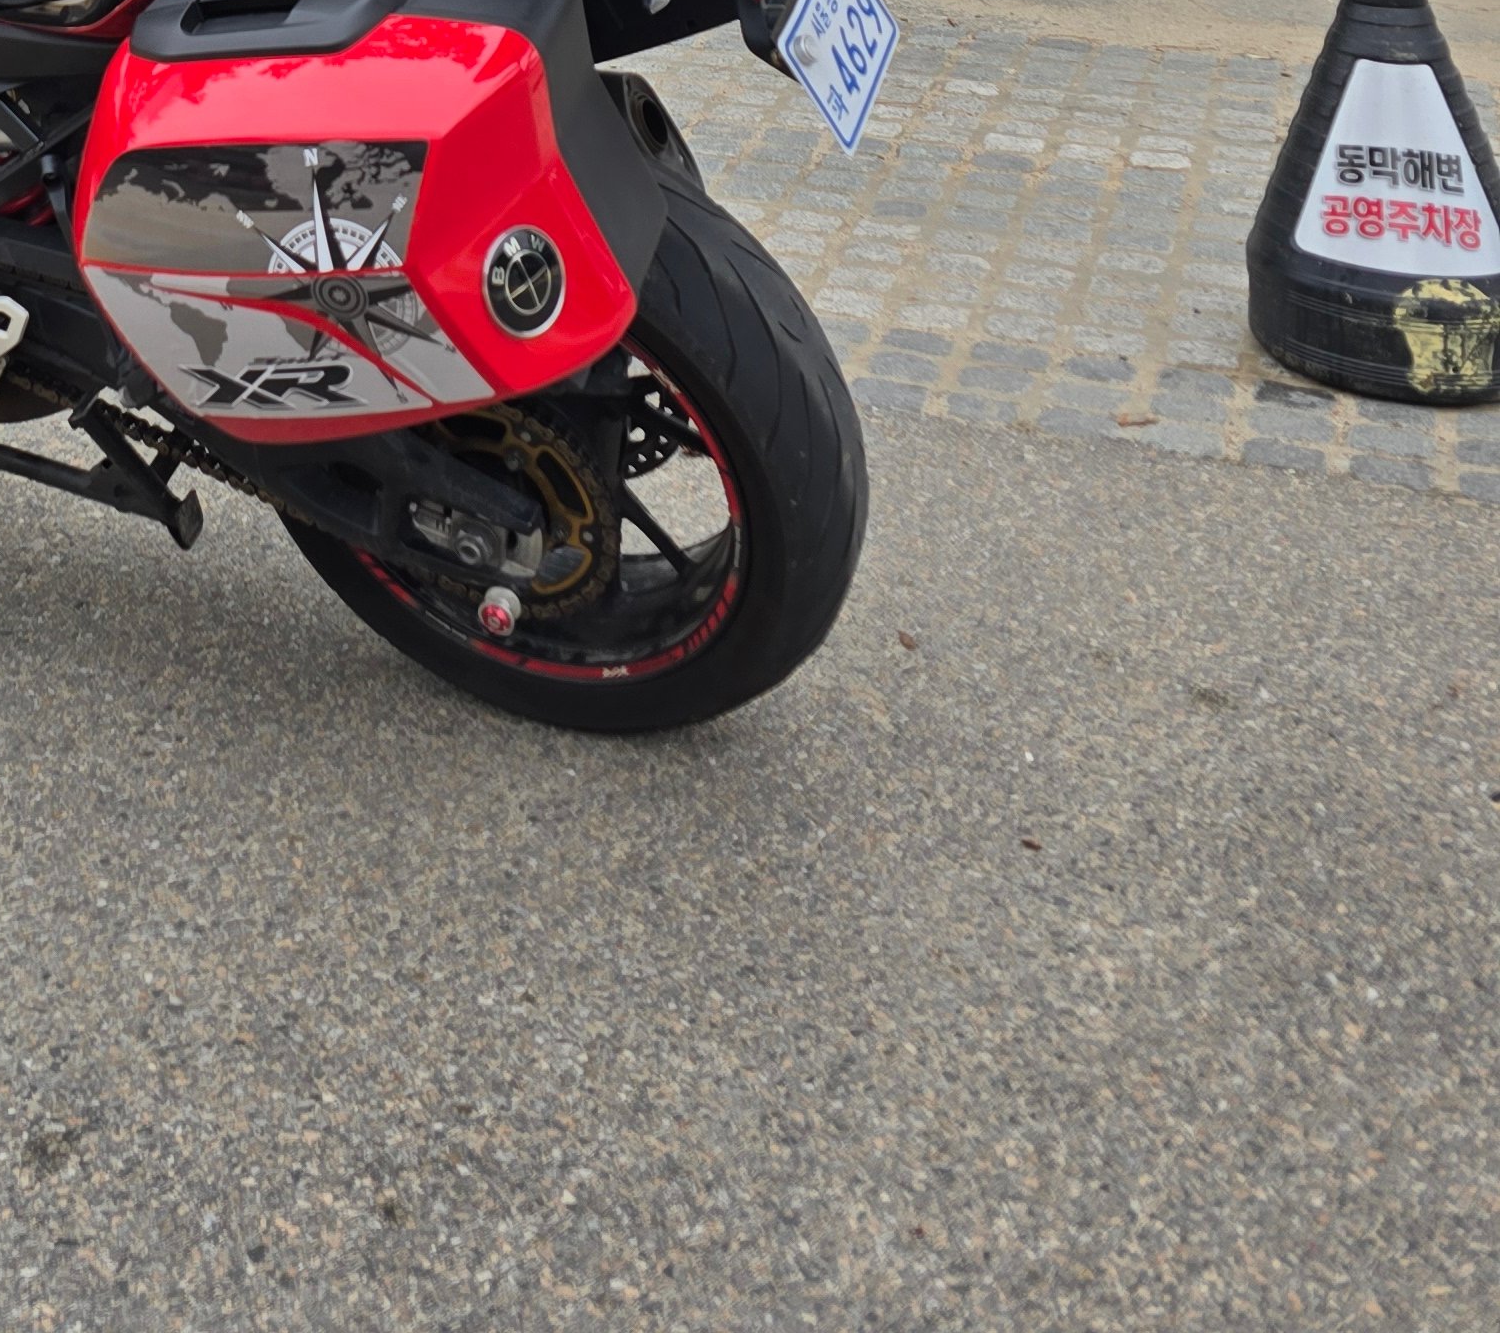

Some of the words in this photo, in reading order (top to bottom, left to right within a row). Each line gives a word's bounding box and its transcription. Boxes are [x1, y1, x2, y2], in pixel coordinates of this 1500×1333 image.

[303, 148, 319, 167] N
[1335, 143, 1465, 194] 동막해변
[1320, 193, 1482, 251] 공영주차장
[178, 364, 369, 411] XR
